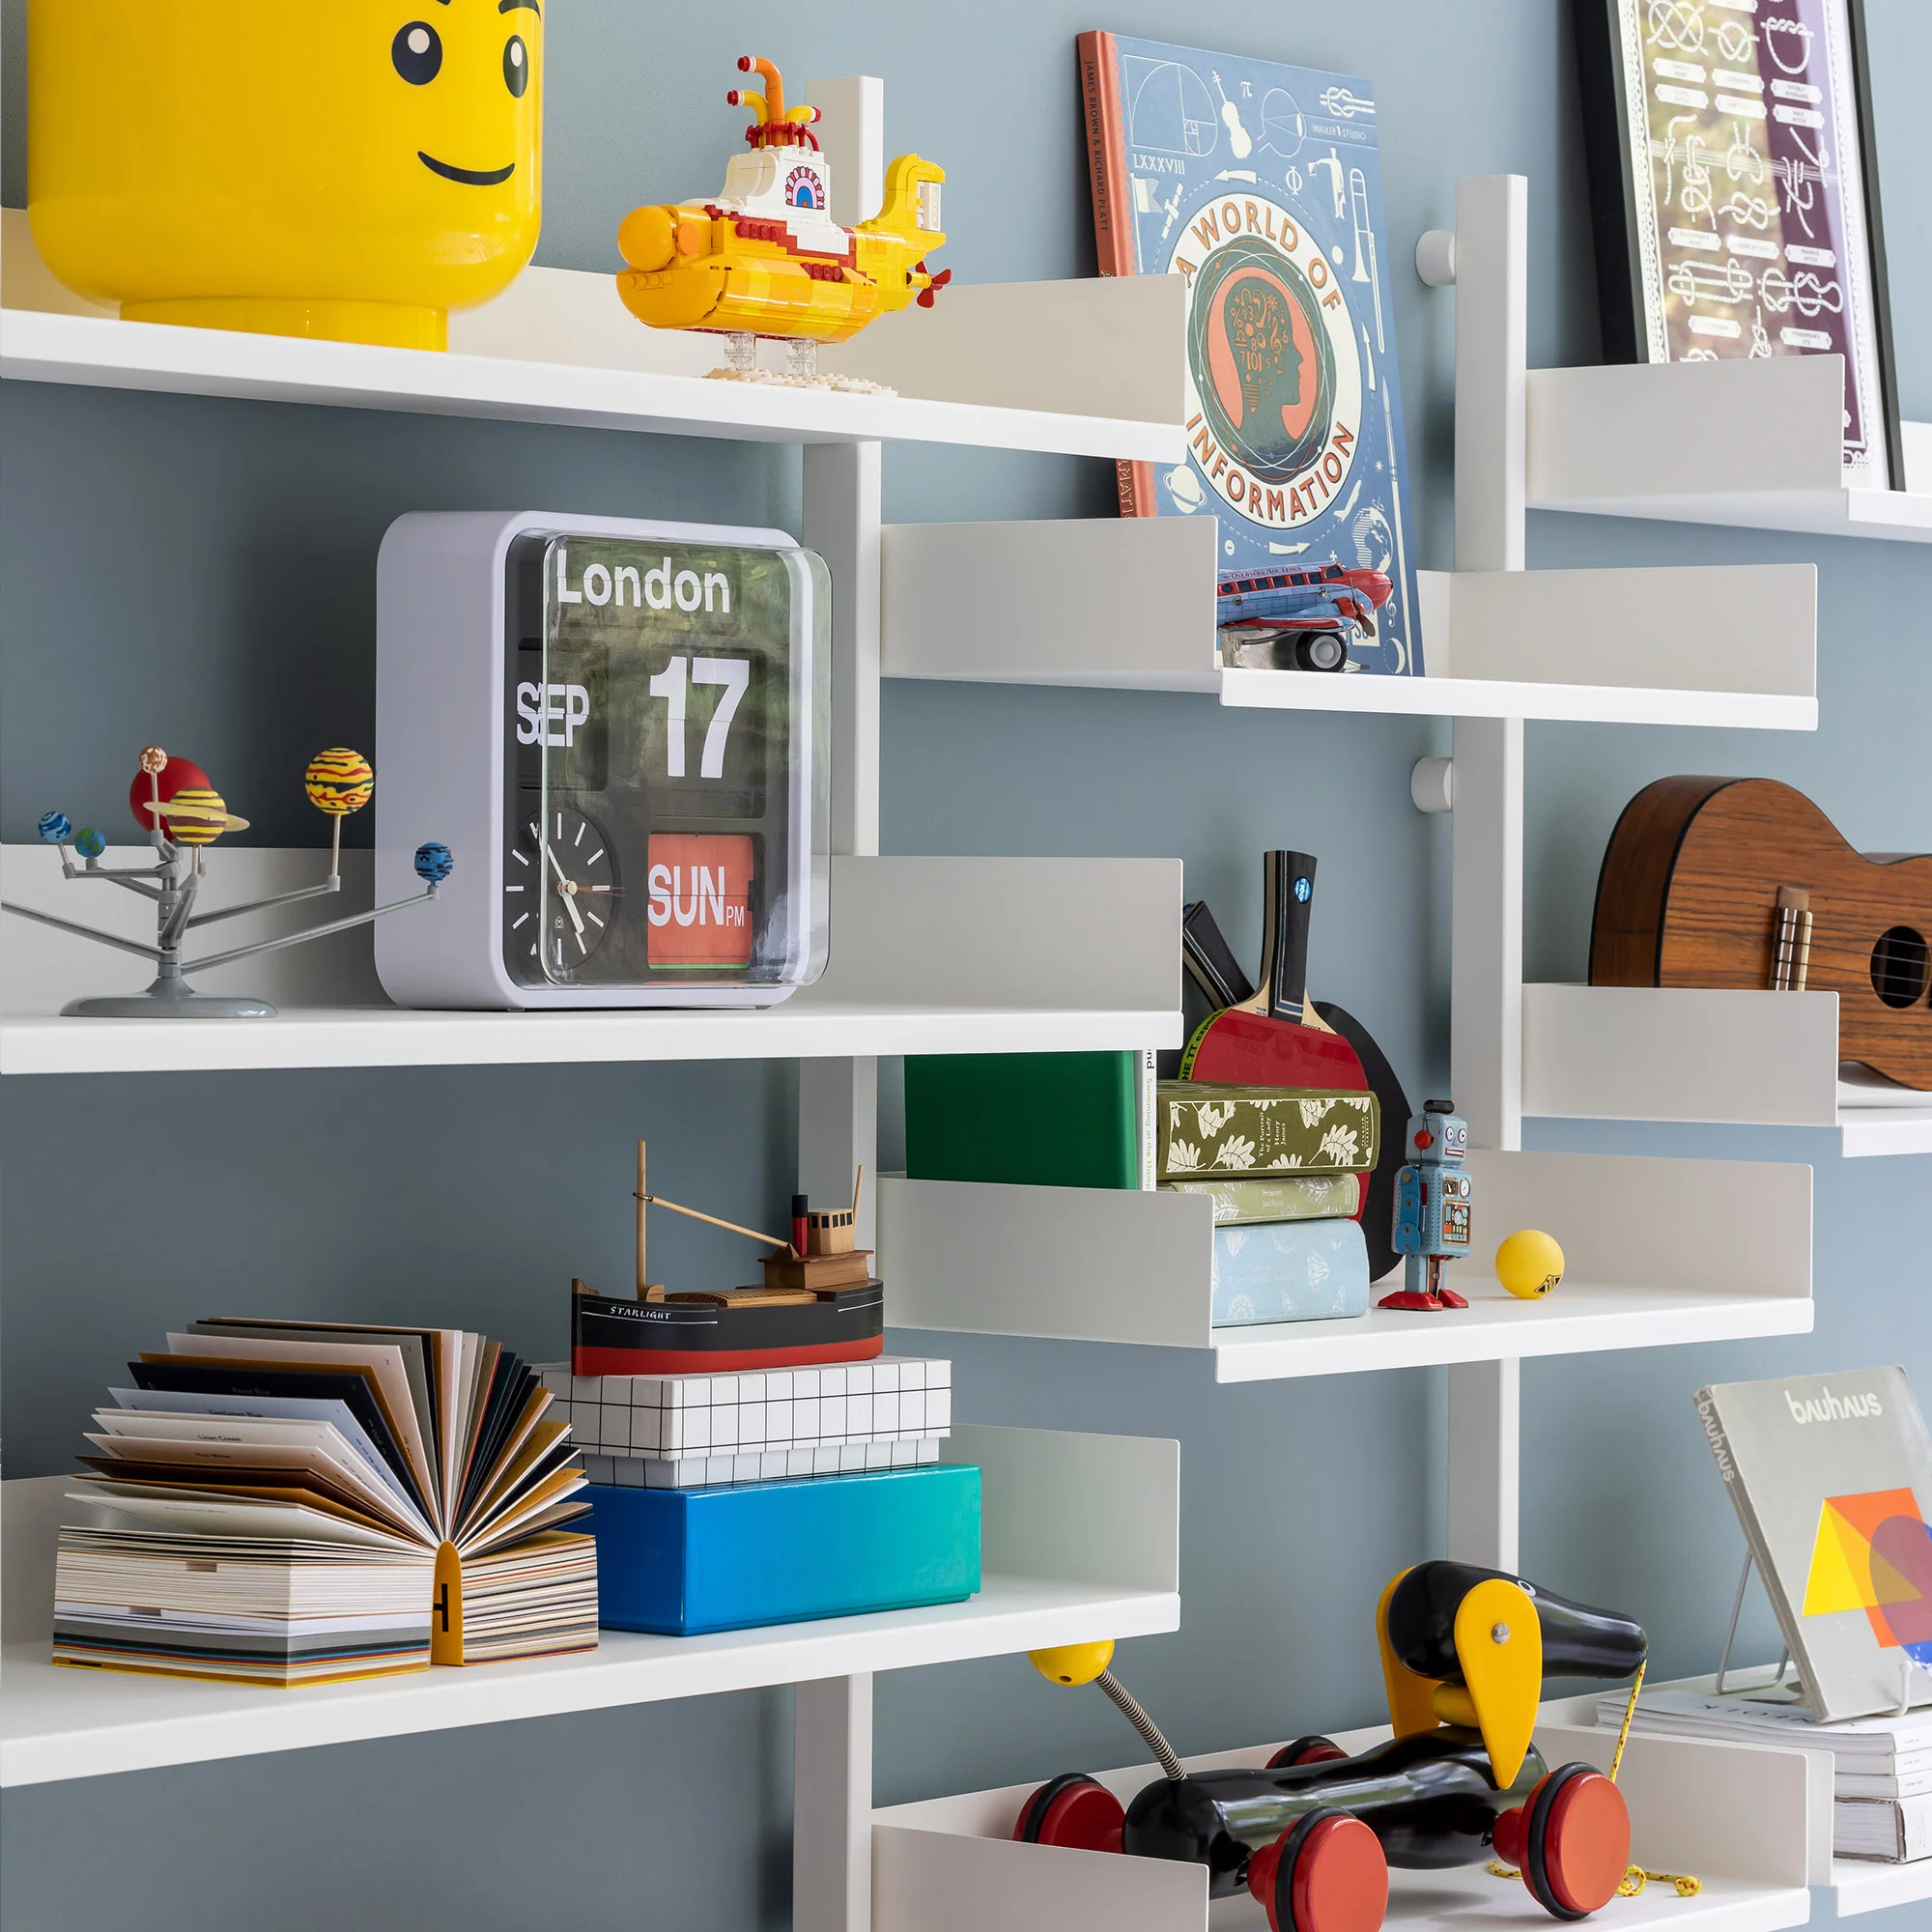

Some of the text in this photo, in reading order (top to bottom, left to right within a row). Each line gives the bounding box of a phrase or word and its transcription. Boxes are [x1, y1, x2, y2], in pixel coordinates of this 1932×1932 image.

[1084, 61, 1096, 94] JAMES
[1089, 97, 1099, 135] BROWN
[1312, 124, 1367, 141] WALKER STUDIO
[1094, 150, 1105, 195] RICHARD
[1132, 154, 1186, 175] LXXXVIII
[1098, 199, 1108, 232] PLATT
[1176, 200, 1342, 311] A WORLD OF
[1186, 412, 1354, 522] INFORMATION
[556, 549, 730, 613] London
[516, 681, 590, 748] SEP
[649, 656, 751, 779] 17
[648, 865, 745, 927] SUN PM
[1146, 1050, 1155, 1069] nd
[1186, 1044, 1198, 1060] TT
[610, 1306, 671, 1320] STARLIGHT
[1784, 1387, 1883, 1424] bauhaus
[1697, 1400, 1735, 1482] bauhaus
